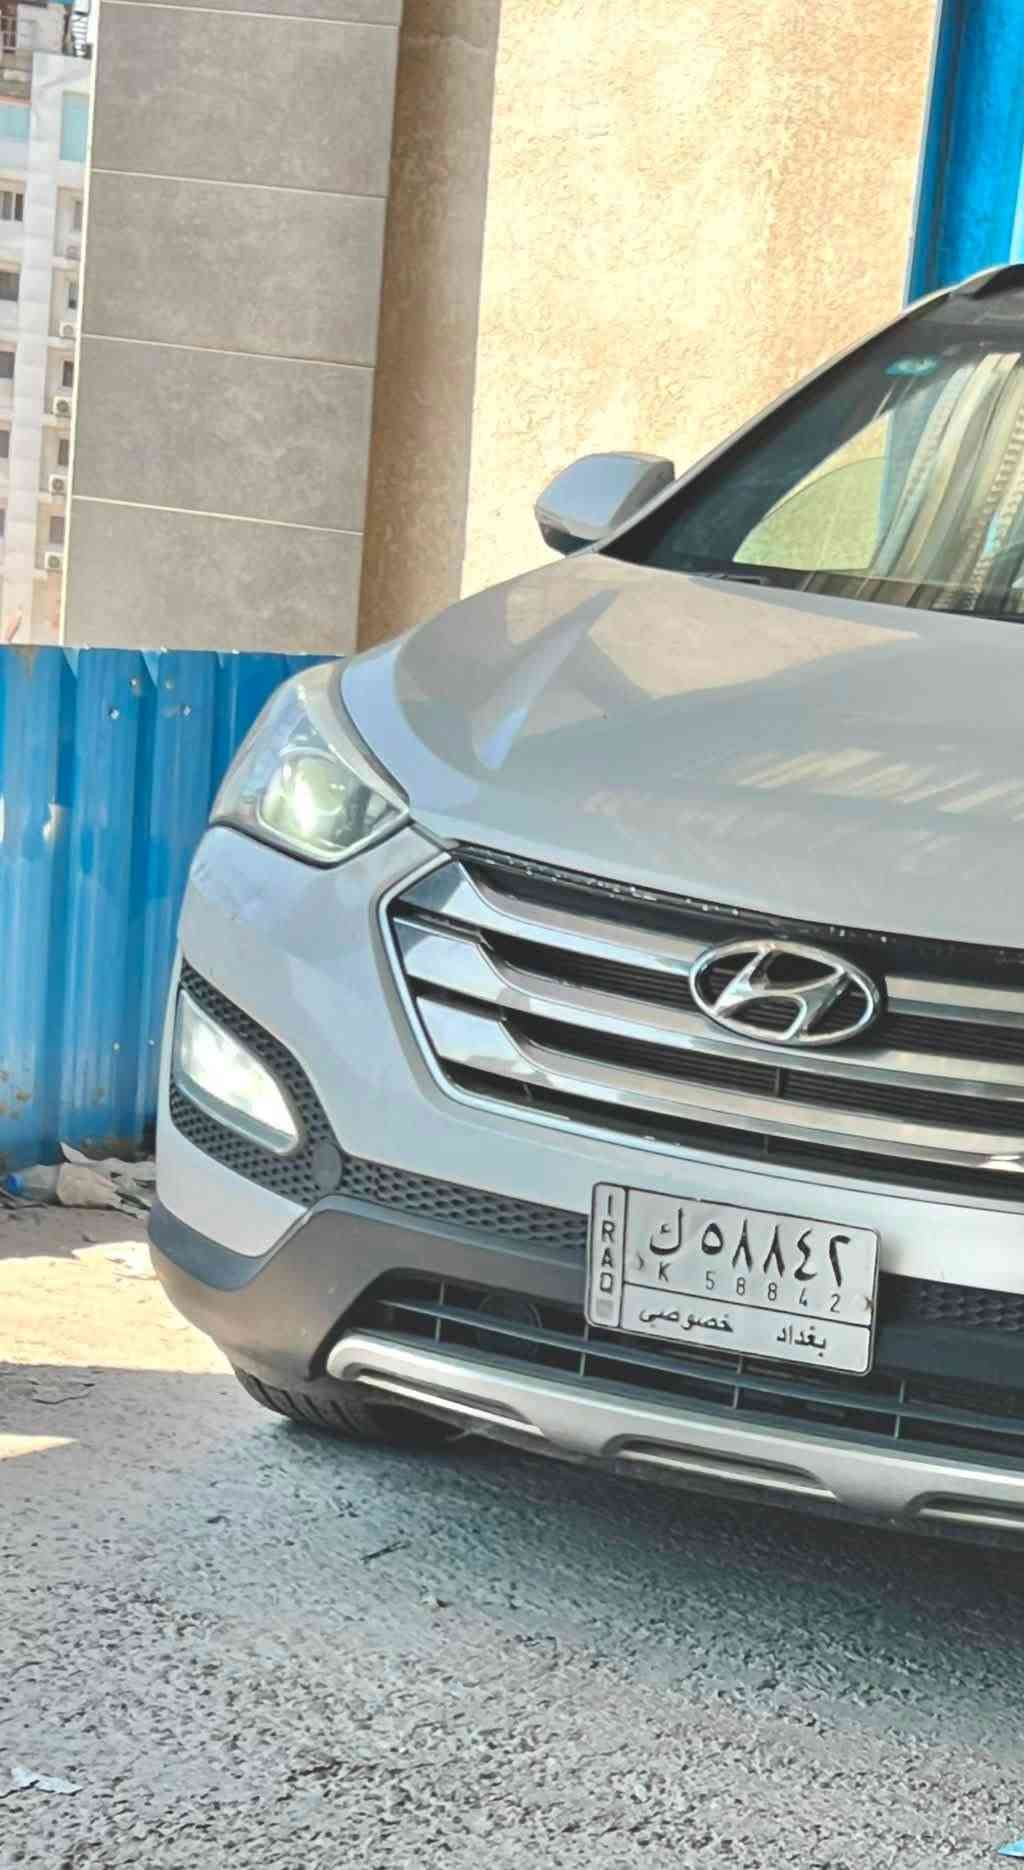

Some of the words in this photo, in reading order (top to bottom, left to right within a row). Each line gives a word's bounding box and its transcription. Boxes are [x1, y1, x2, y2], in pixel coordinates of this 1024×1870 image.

[600, 1194, 616, 1294] IRAQ
[658, 1261, 671, 1282] K
[705, 1270, 841, 1314] 58842
[639, 1309, 734, 1333] خصوصي
[776, 1325, 827, 1358] بغداد
